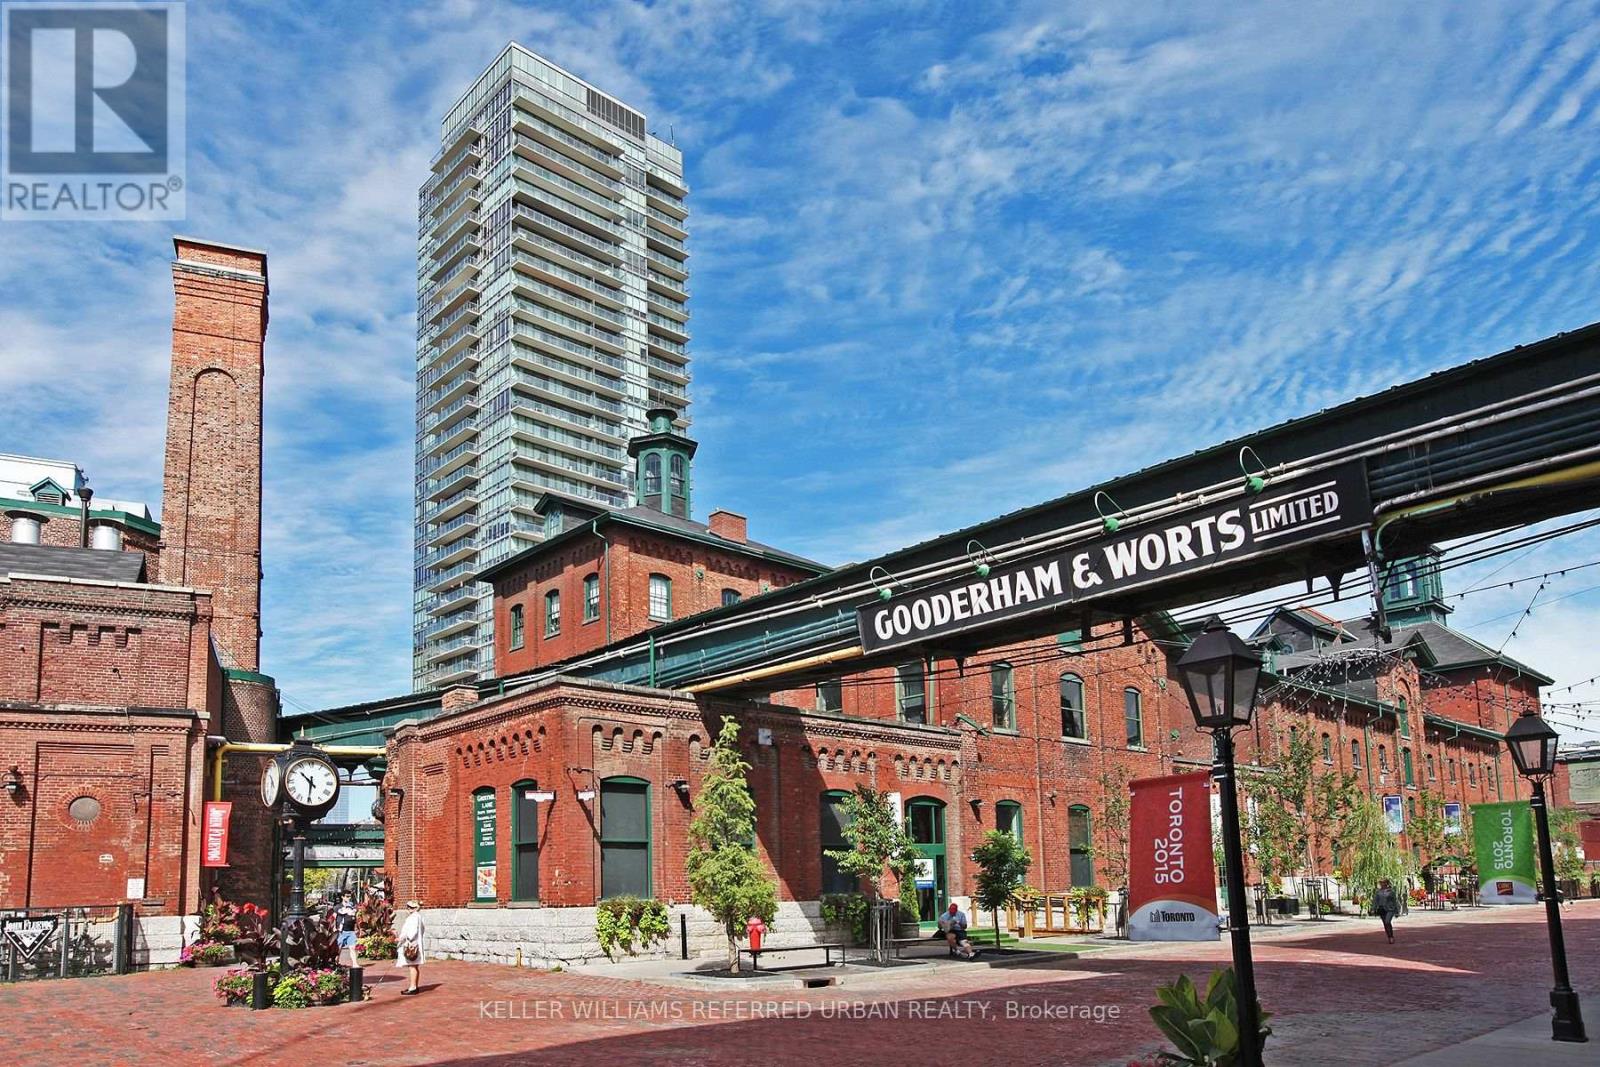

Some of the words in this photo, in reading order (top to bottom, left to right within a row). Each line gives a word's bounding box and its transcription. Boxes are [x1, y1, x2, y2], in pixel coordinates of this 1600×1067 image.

[874, 560, 1064, 641] GOODERHAM
[1071, 551, 1103, 591] &
[1103, 507, 1246, 580] WORTS
[1249, 490, 1340, 535] LIMITED
[1154, 838, 1169, 884] 2015
[1168, 786, 1185, 884] TORONTO
[1492, 841, 1504, 870] 2015
[1501, 809, 1514, 869] TORONTO
[1161, 910, 1196, 923] TORONTO
